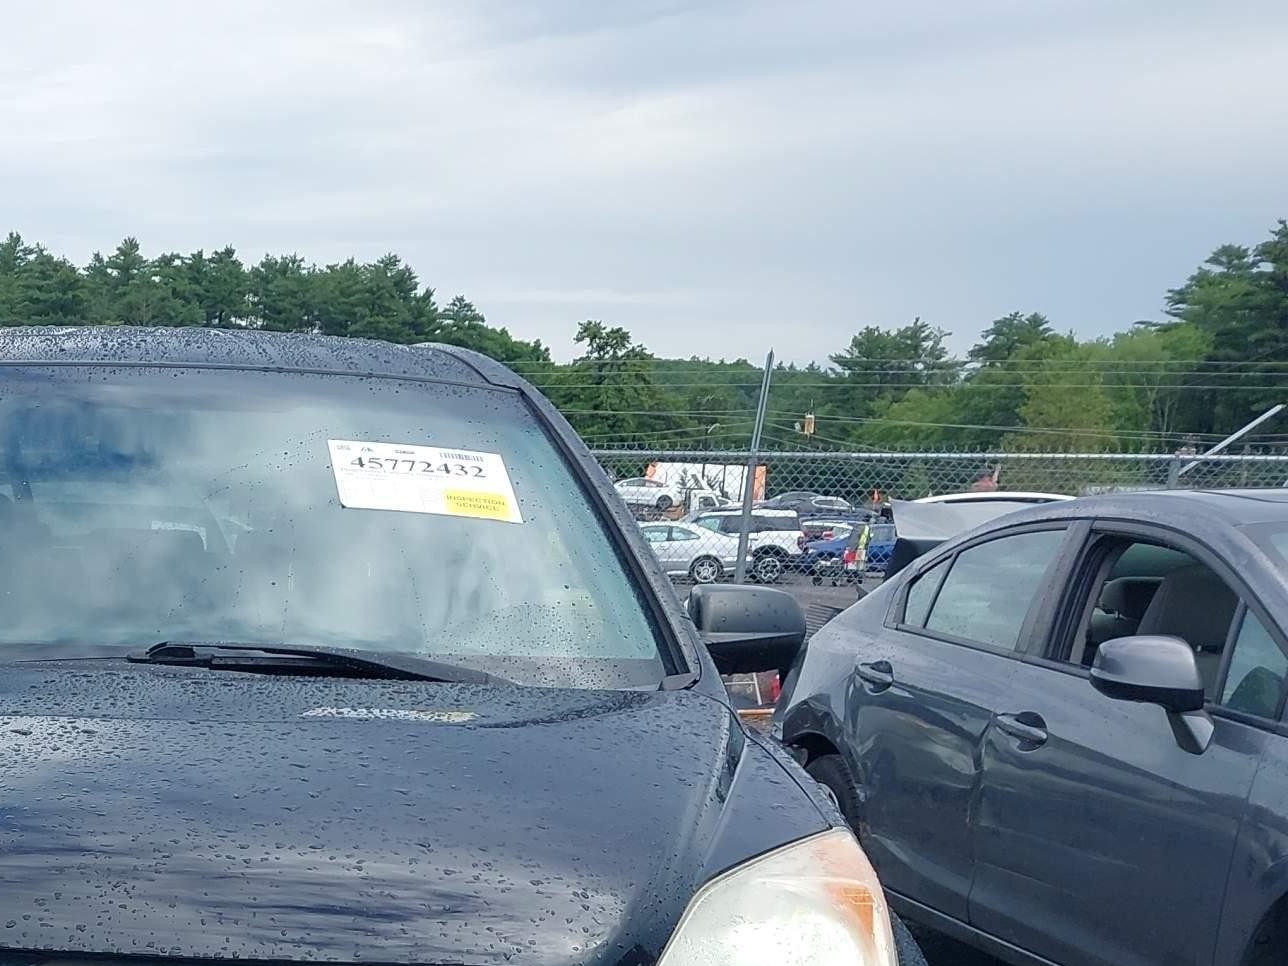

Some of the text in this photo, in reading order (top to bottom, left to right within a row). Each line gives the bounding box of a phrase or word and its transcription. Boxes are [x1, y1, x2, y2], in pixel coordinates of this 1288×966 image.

[350, 456, 487, 478] 45772432
[446, 494, 506, 506] INSPECTION
[456, 501, 501, 512] SERVICE
